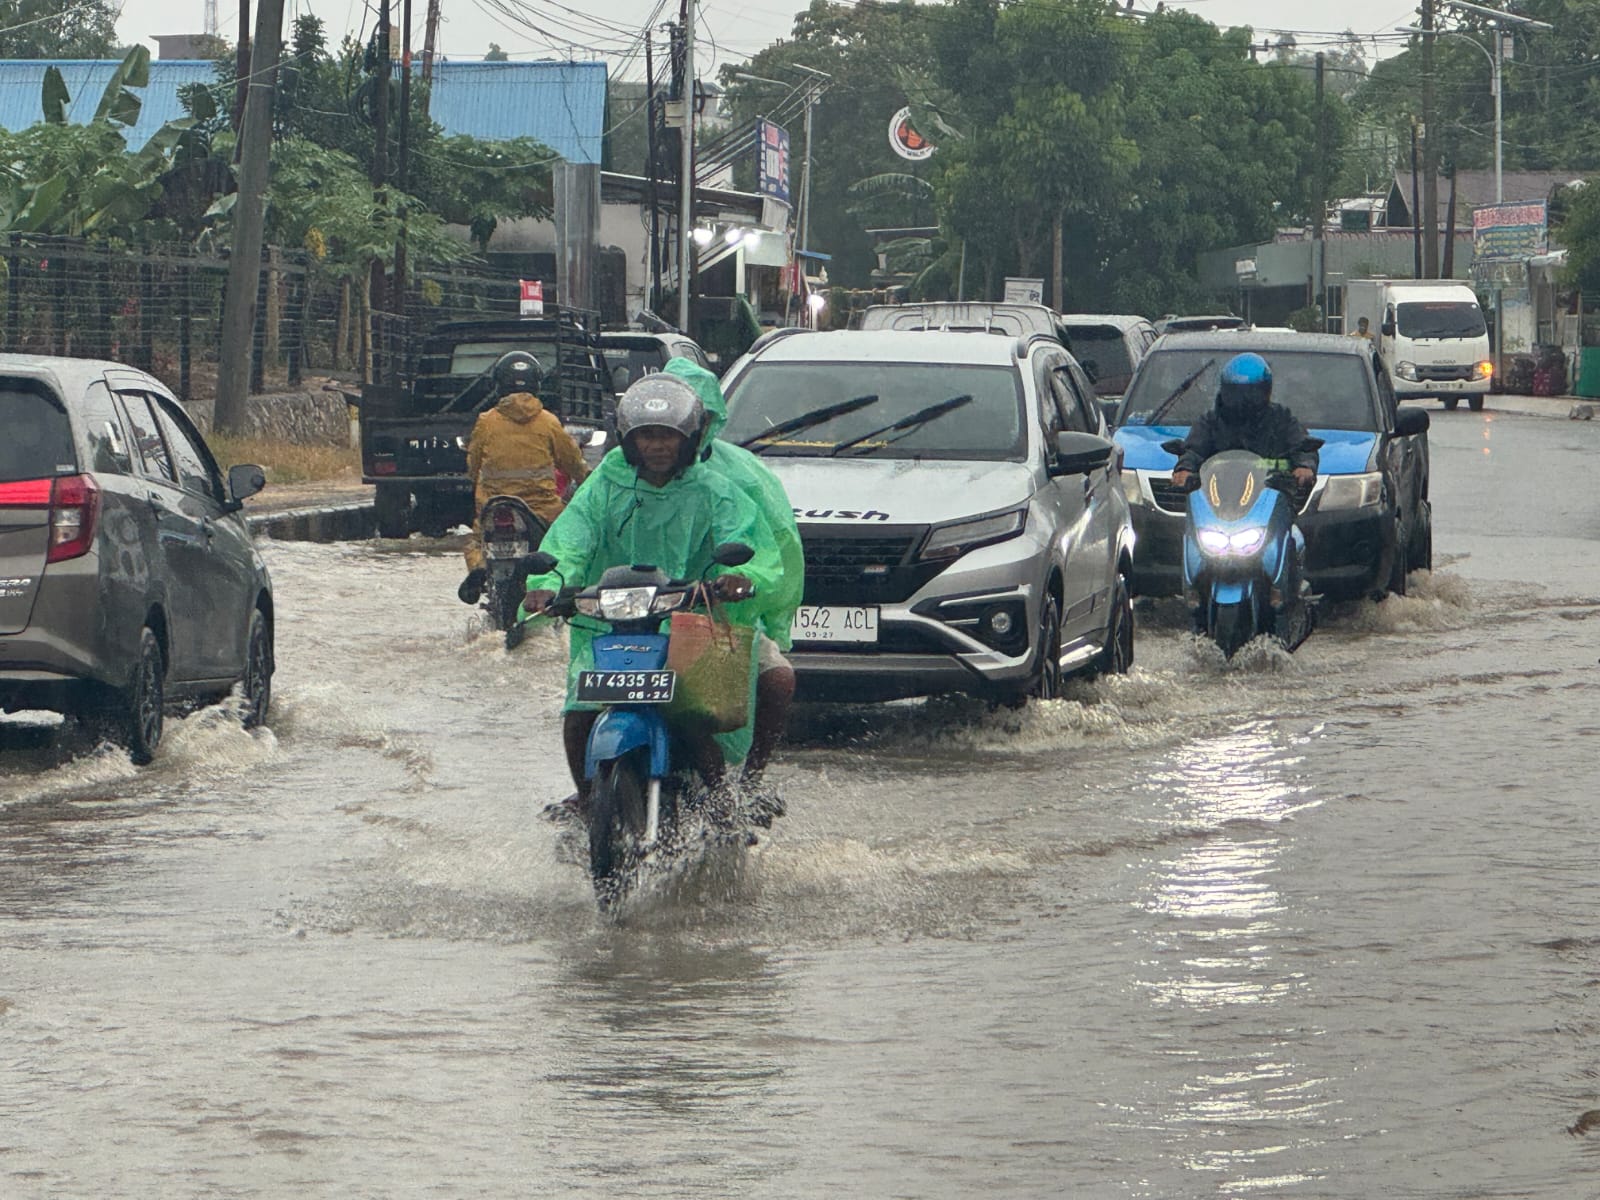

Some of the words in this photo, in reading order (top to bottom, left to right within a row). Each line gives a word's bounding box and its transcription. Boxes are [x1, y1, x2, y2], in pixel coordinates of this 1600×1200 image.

[844, 610, 874, 629] ACL
[584, 673, 604, 687] KT
[606, 673, 646, 687] 4335
